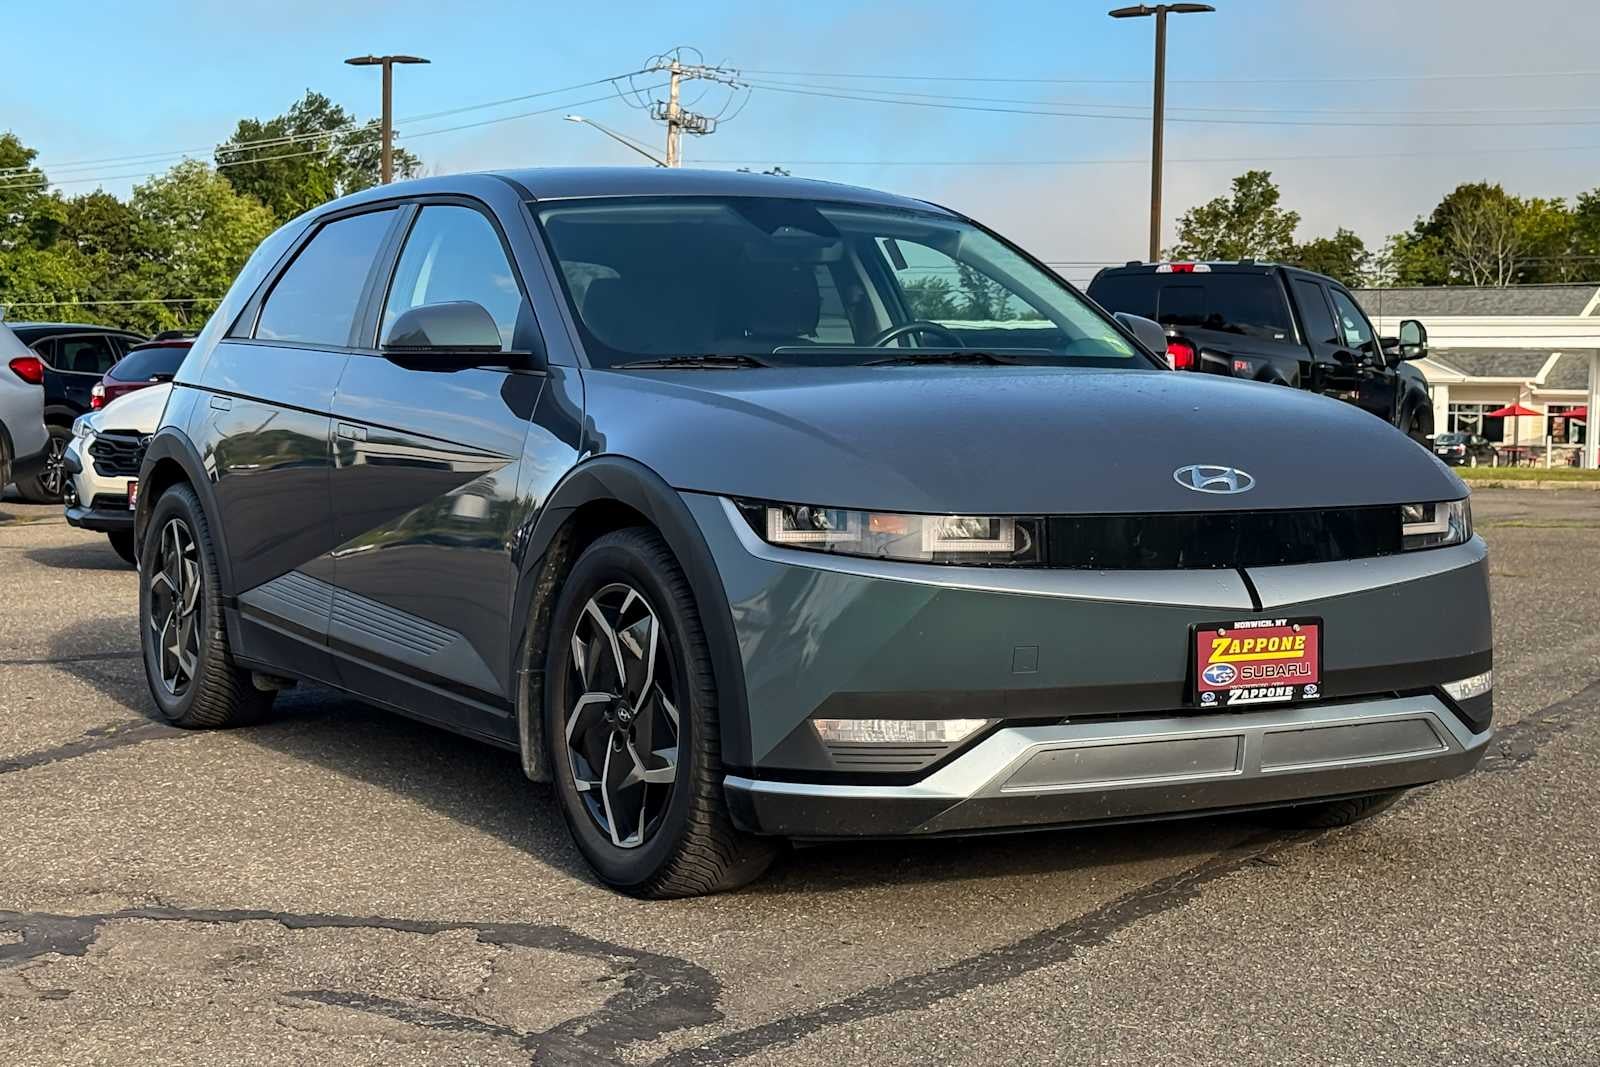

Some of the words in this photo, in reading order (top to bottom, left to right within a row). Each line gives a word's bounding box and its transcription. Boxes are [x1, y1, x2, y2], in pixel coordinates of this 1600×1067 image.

[1208, 635, 1306, 663] ZAPPONE
[1240, 662, 1311, 680] SUBARU
[1227, 686, 1293, 705] ZAPPONE
